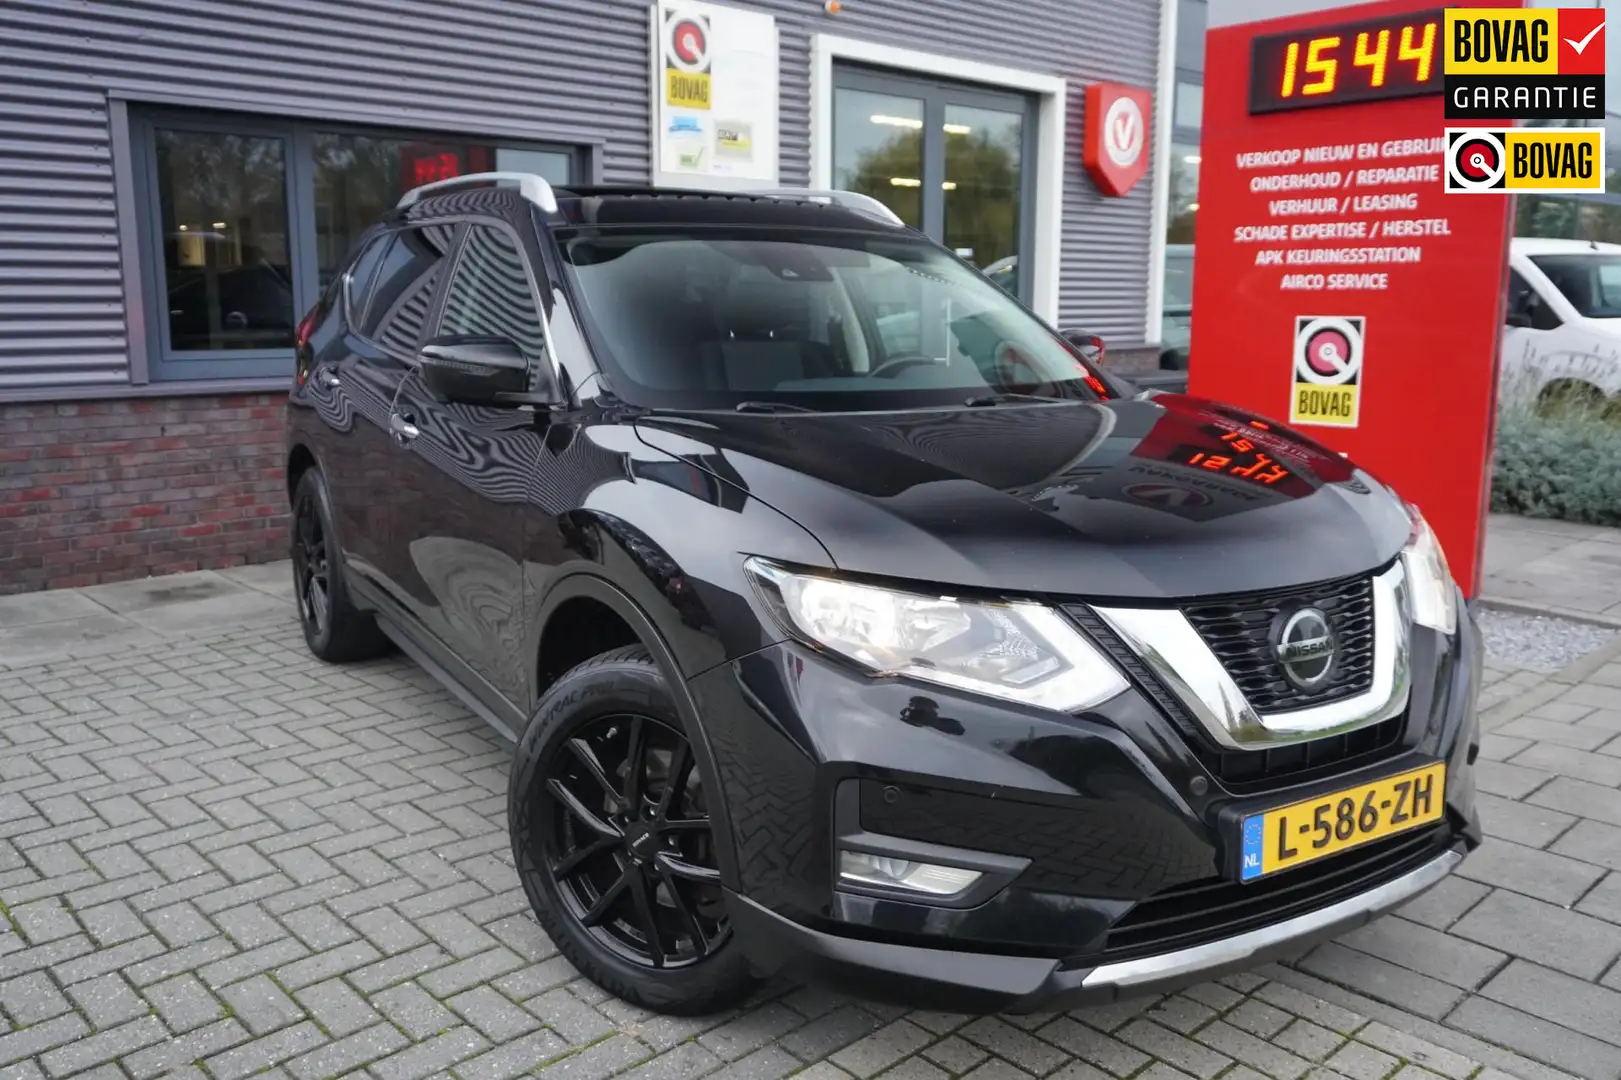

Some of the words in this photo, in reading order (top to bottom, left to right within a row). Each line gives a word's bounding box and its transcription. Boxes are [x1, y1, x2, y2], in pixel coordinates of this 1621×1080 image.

[670, 75, 708, 103] BOVAG
[1236, 149, 1301, 169] VERKOOP
[1304, 145, 1354, 163] NIEUW
[1358, 142, 1378, 159] EN
[1250, 172, 1341, 192] ONDERHOUD
[1356, 165, 1439, 186] REPARATIE
[1269, 197, 1338, 216] VERHUUR
[1353, 193, 1418, 212] LEASING
[1234, 224, 1288, 242] SCHADE
[1291, 222, 1367, 240] EXPERTISE
[1382, 219, 1451, 237] HERSTEL
[1255, 250, 1284, 265] APK
[1287, 247, 1421, 265] KEURINGSSTATION
[1280, 274, 1324, 289] AIRCO
[1328, 273, 1388, 289] SERVICE
[1298, 390, 1351, 417] BOVAG
[1285, 638, 1332, 657] NISSAN
[1278, 774, 1433, 861] L-586-ZH
[1244, 853, 1260, 868] NL
